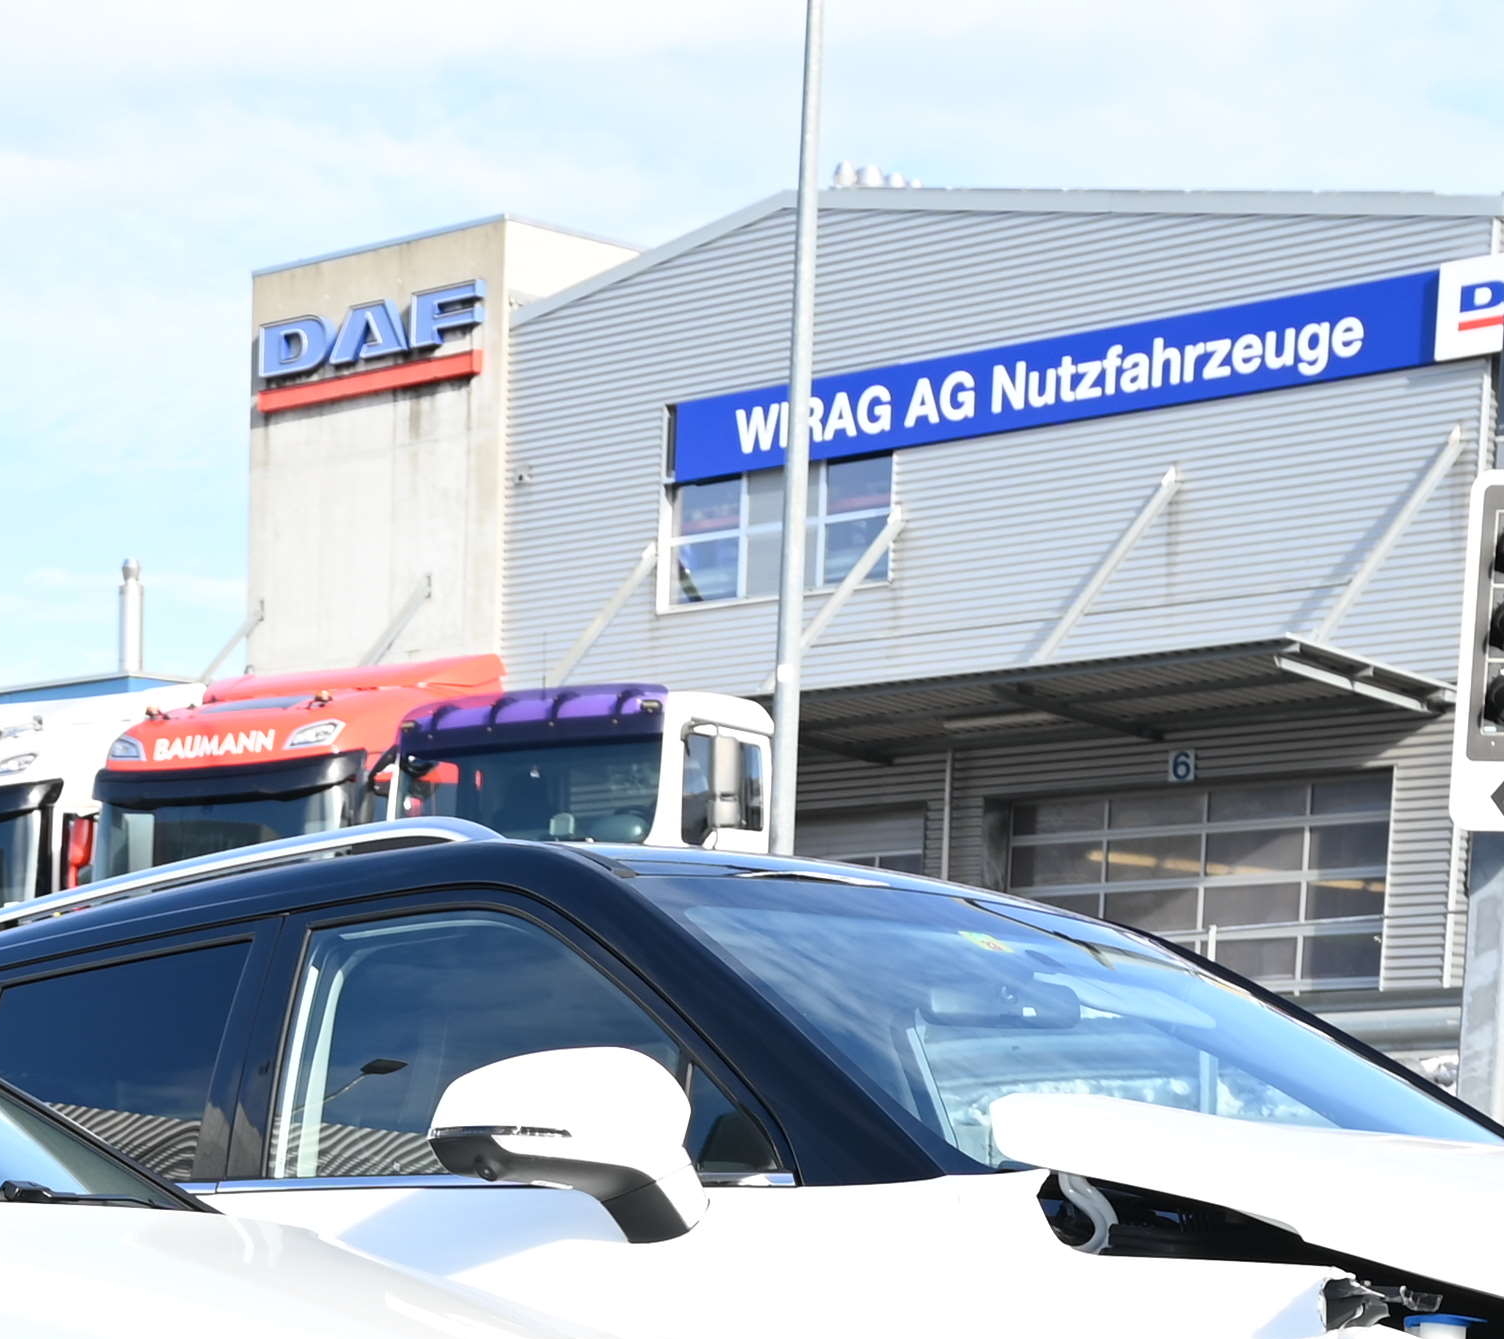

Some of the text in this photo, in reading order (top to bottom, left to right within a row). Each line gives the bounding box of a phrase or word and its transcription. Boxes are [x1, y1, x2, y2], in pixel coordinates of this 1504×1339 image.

[258, 279, 486, 378] DAF
[736, 316, 1365, 454] WIRAG AG Nutzfahrzeuge
[153, 728, 276, 761] BAUMANN
[1173, 751, 1191, 780] 6
